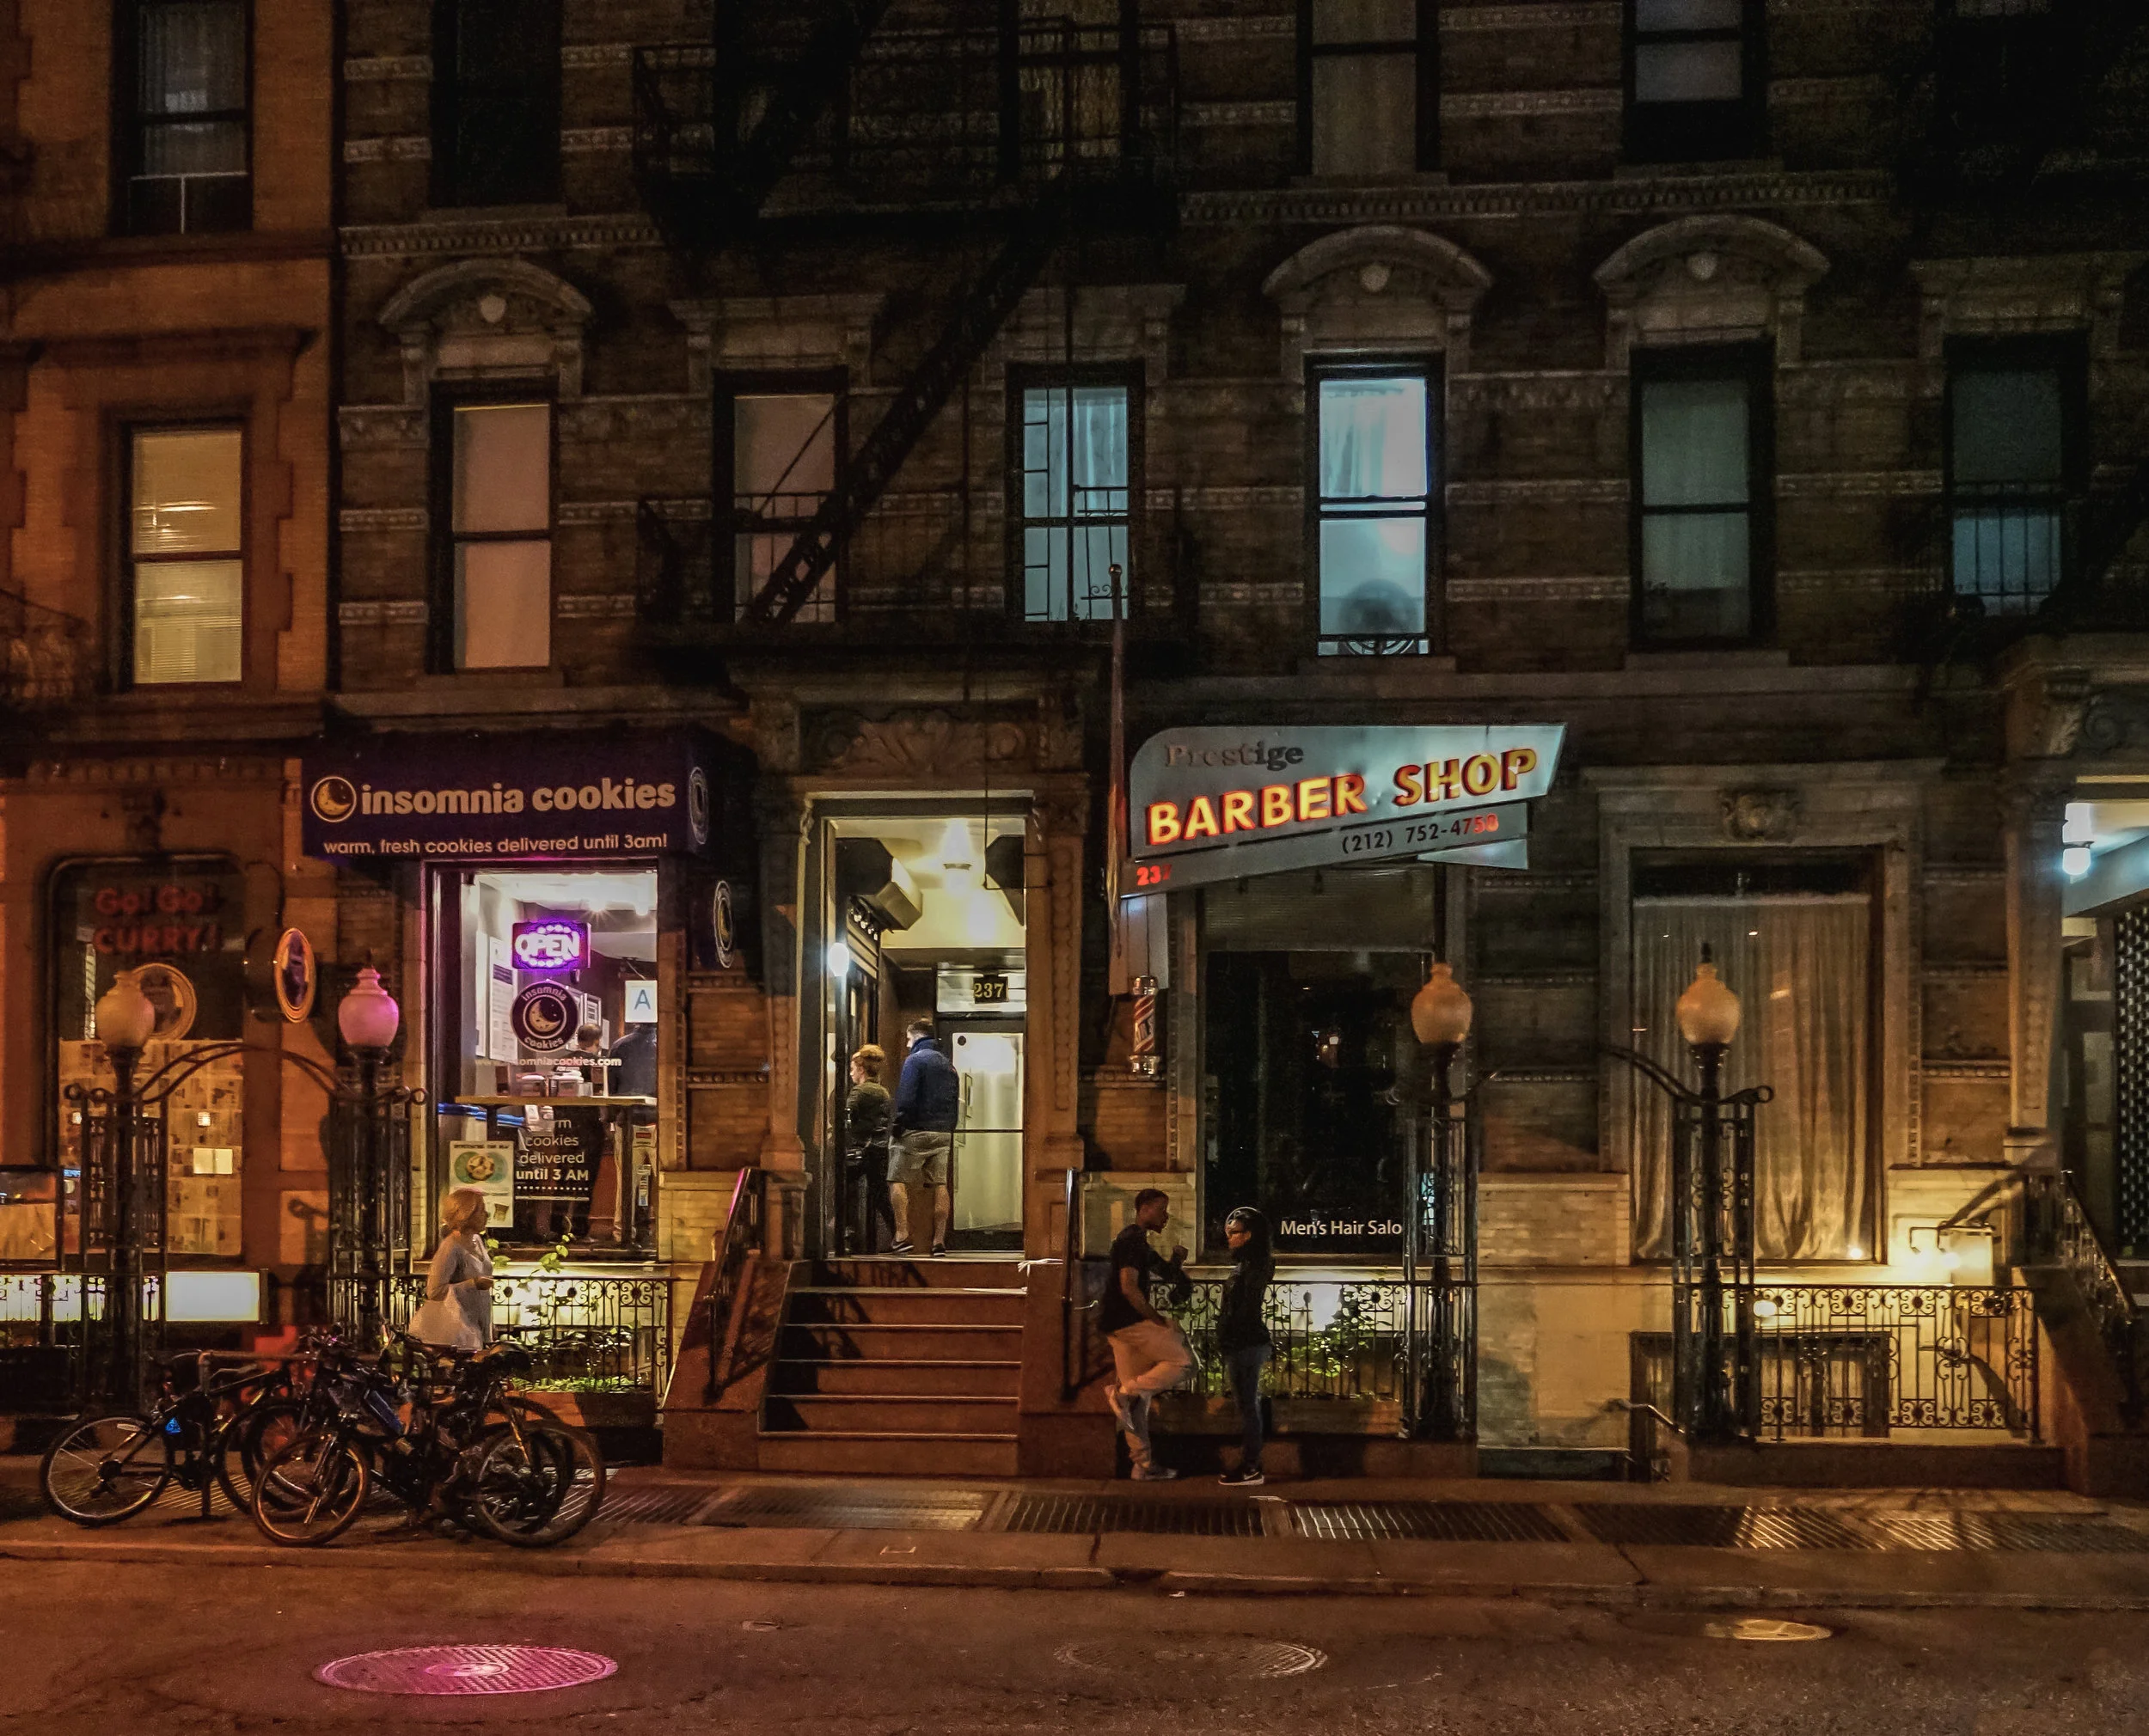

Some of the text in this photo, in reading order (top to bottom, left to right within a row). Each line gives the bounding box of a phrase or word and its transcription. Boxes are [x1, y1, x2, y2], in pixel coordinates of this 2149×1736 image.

[1166, 741, 1304, 772] Prestige
[361, 782, 524, 815] insomnia
[531, 777, 677, 811] cookies
[1147, 748, 1538, 846] BARBER SHOP
[380, 838, 420, 853] fresh
[425, 838, 493, 853] cookies
[497, 835, 579, 853] delivered
[583, 834, 619, 849] until
[623, 833, 668, 849] 3am!
[1342, 830, 1393, 854] (212)
[1136, 864, 1172, 887] 237
[515, 931, 580, 958] OPEN
[522, 986, 567, 1002] insomnia
[634, 988, 651, 1010] A
[974, 982, 1004, 998] 237
[523, 1036, 565, 1050] cookies
[525, 1134, 579, 1147] cookies
[519, 1152, 585, 1164] delivered
[516, 1168, 589, 1181] until 3 AM
[1281, 1219, 1402, 1235] Men's Hair Salo
